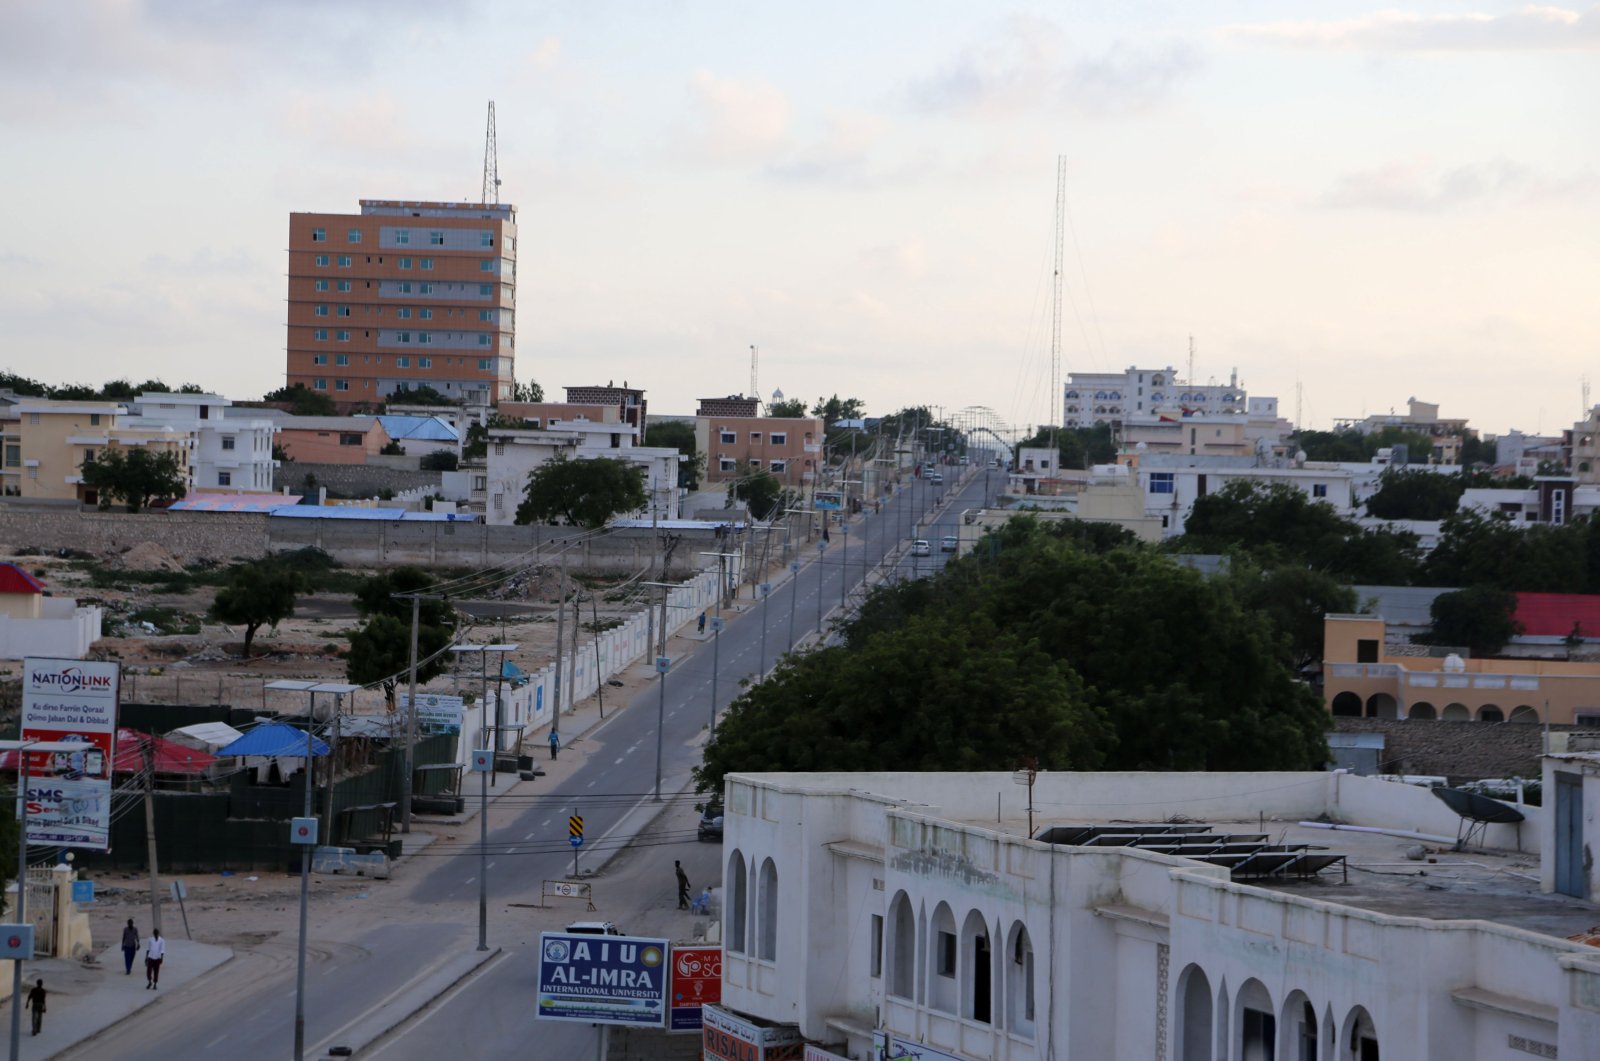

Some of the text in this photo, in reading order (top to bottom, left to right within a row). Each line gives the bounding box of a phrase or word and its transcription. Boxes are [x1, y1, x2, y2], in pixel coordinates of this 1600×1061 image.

[32, 673, 111, 686] NATIONLINK
[27, 788, 63, 803] SMS
[551, 966, 653, 989] AL-IMRA
[543, 985, 660, 999] INTERNATIONAL UNIVERSITY
